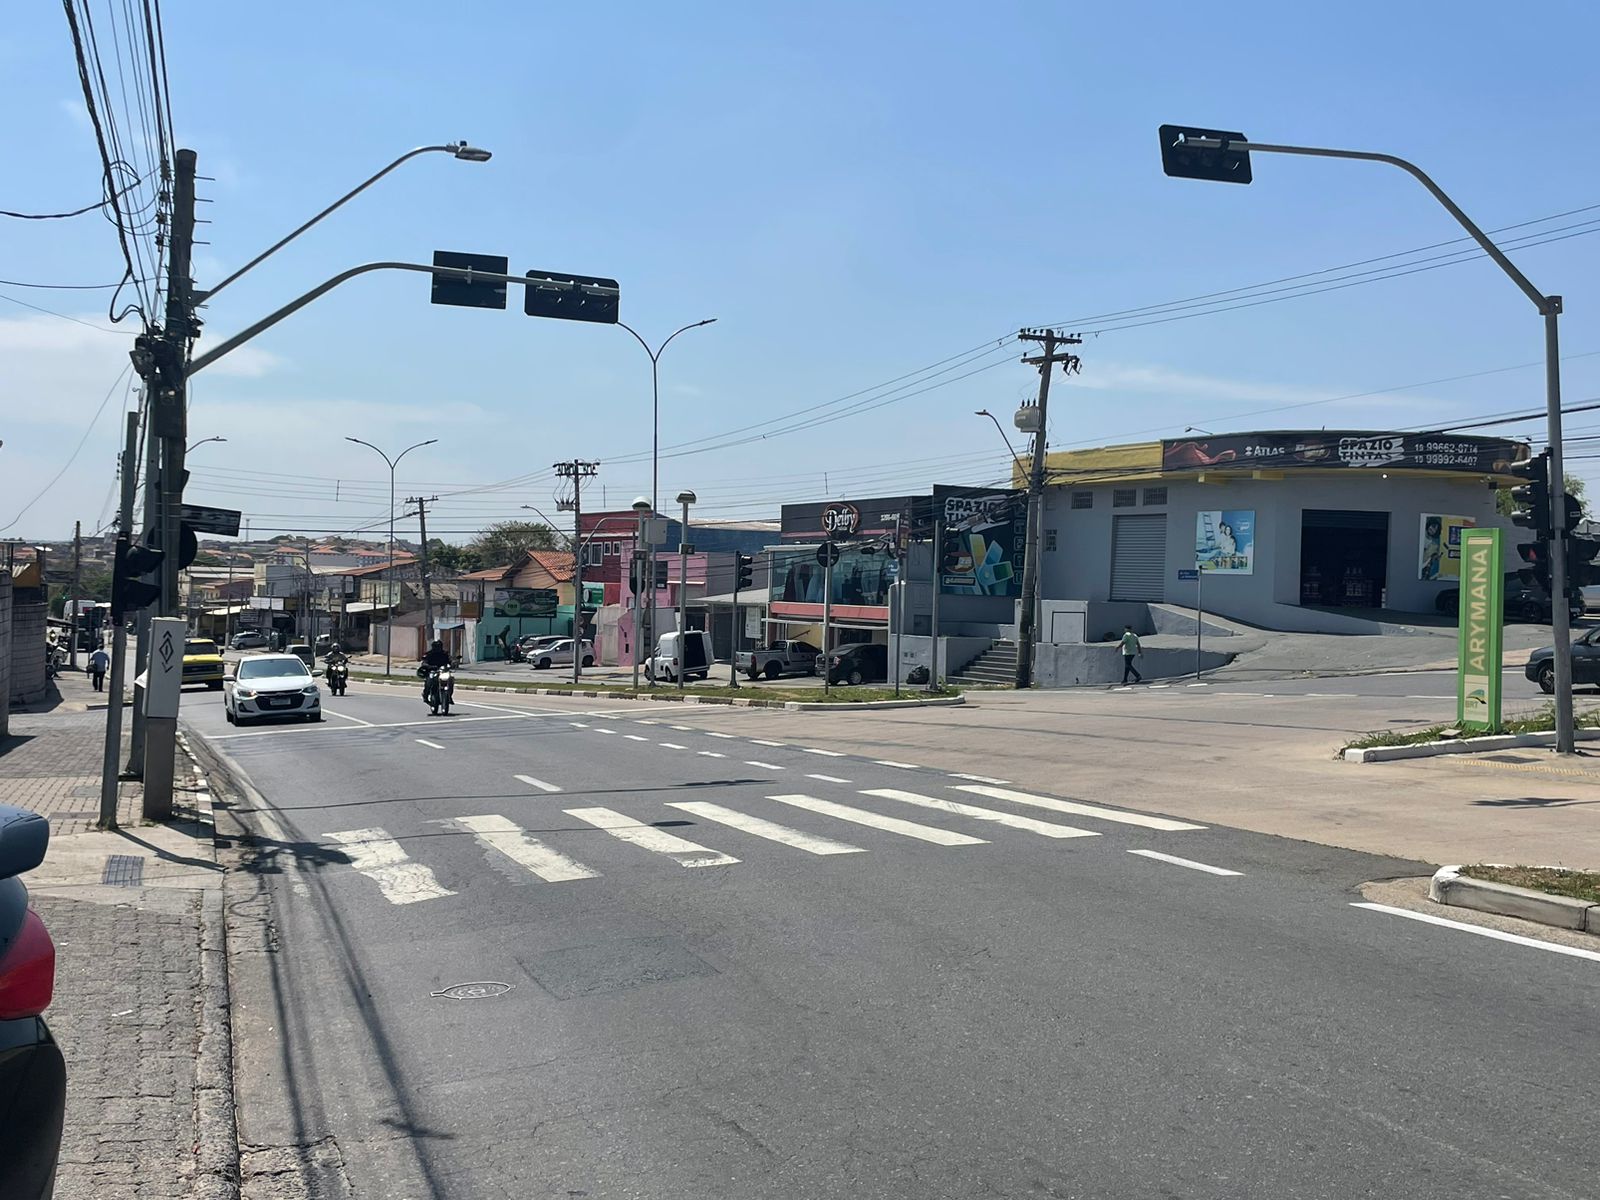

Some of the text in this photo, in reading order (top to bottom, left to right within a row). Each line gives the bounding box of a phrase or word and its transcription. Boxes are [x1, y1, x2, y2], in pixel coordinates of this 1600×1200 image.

[1340, 438, 1393, 451] SPAZIO
[1253, 445, 1285, 457] ATLAS
[1341, 450, 1393, 461] TINTAS
[1469, 548, 1488, 671] ARYMANA
